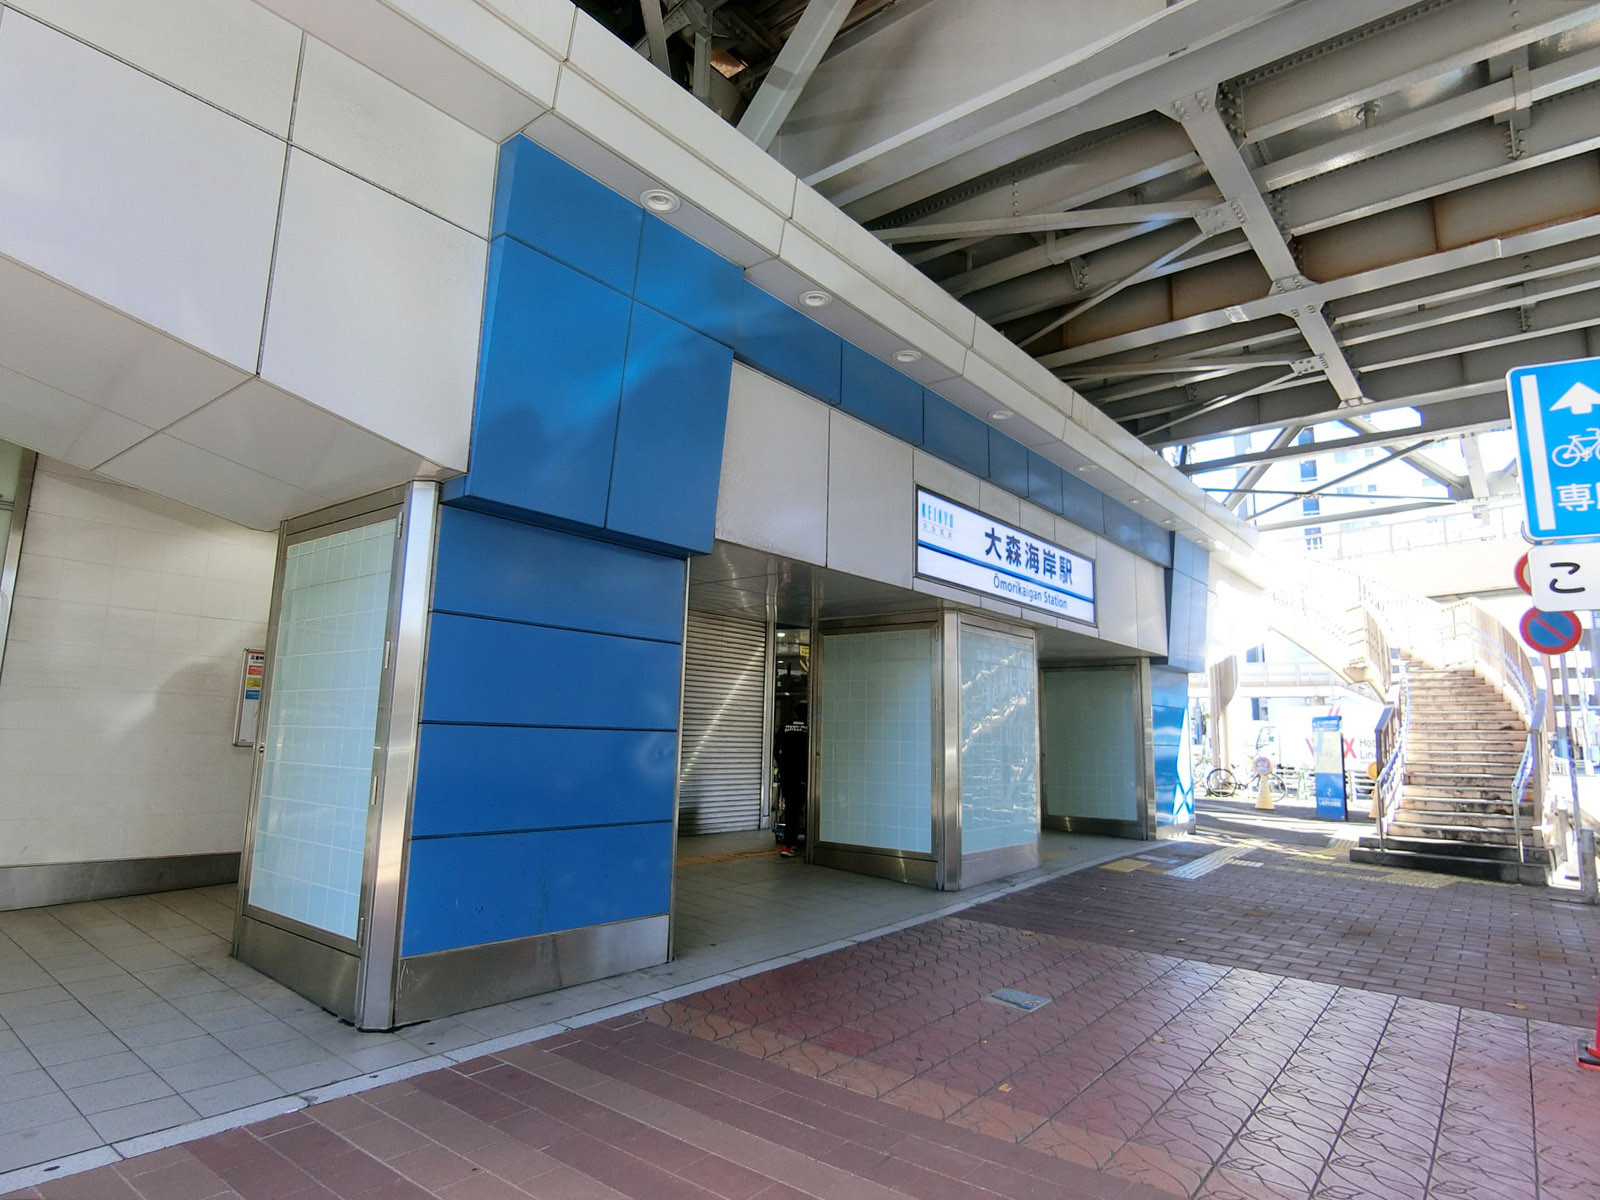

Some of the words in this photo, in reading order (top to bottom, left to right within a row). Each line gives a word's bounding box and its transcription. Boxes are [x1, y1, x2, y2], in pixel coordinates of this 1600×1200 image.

[1556, 482, 1600, 511] 専
[984, 527, 1073, 586] 大森海岸駅
[1044, 591, 1068, 609] Station
